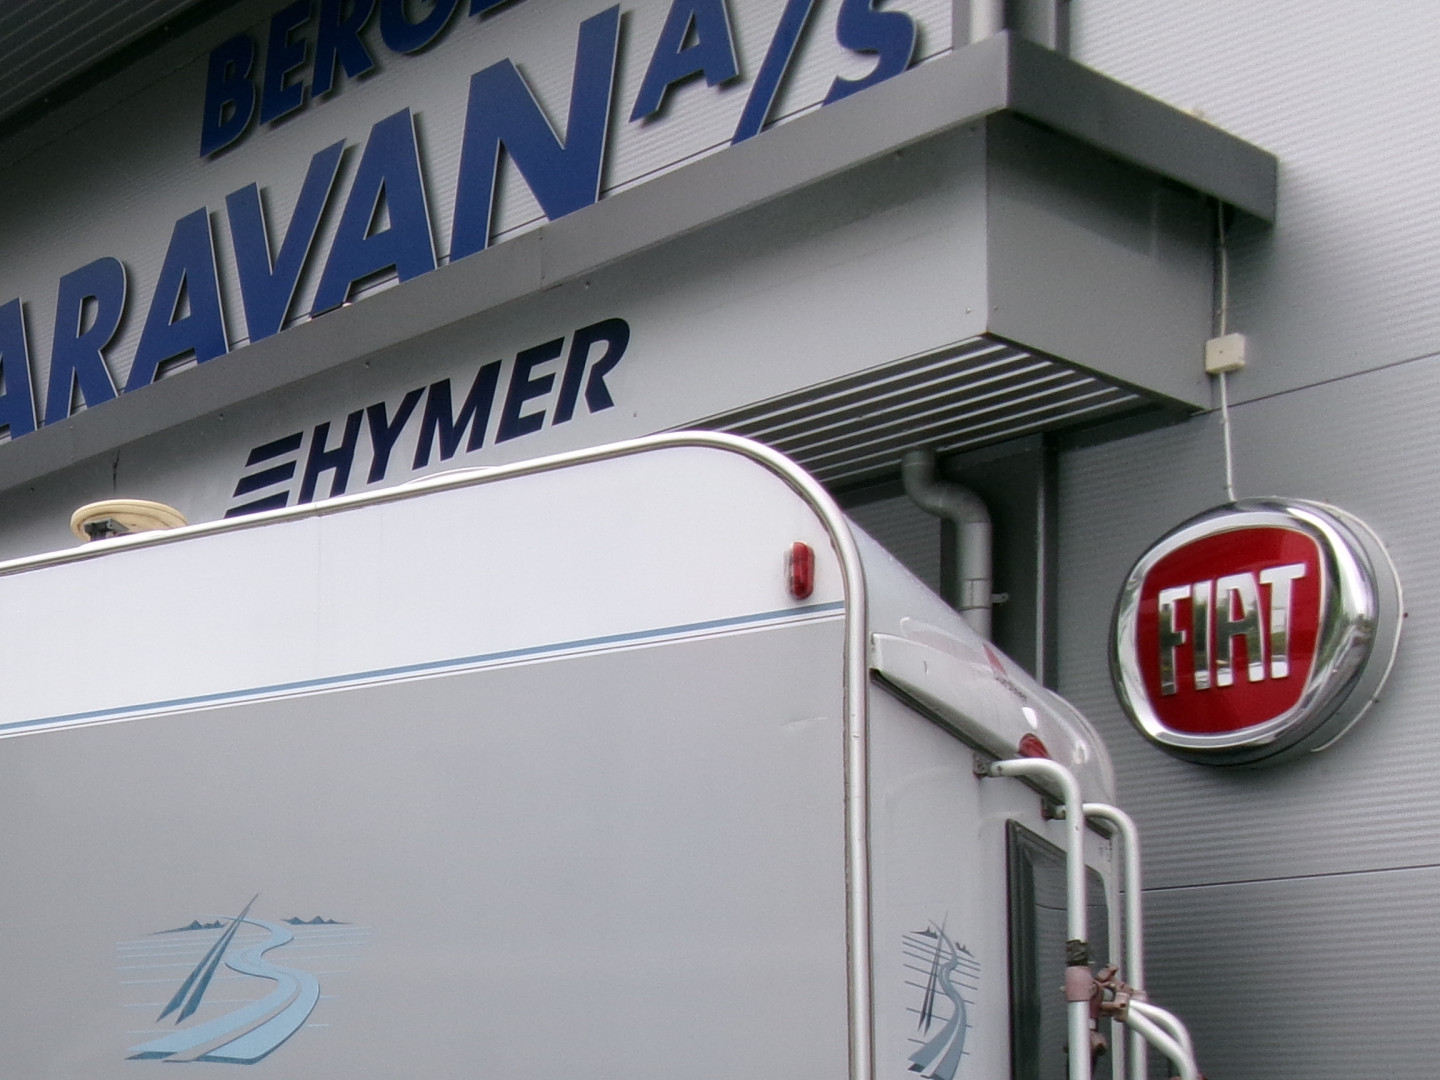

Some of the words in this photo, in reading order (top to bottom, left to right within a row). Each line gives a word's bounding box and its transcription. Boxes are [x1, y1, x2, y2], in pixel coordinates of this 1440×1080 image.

[200, 0, 507, 158] BERG
[629, 0, 916, 146] A/S
[298, 317, 631, 505] HYMER
[1158, 562, 1307, 696] FIAT
